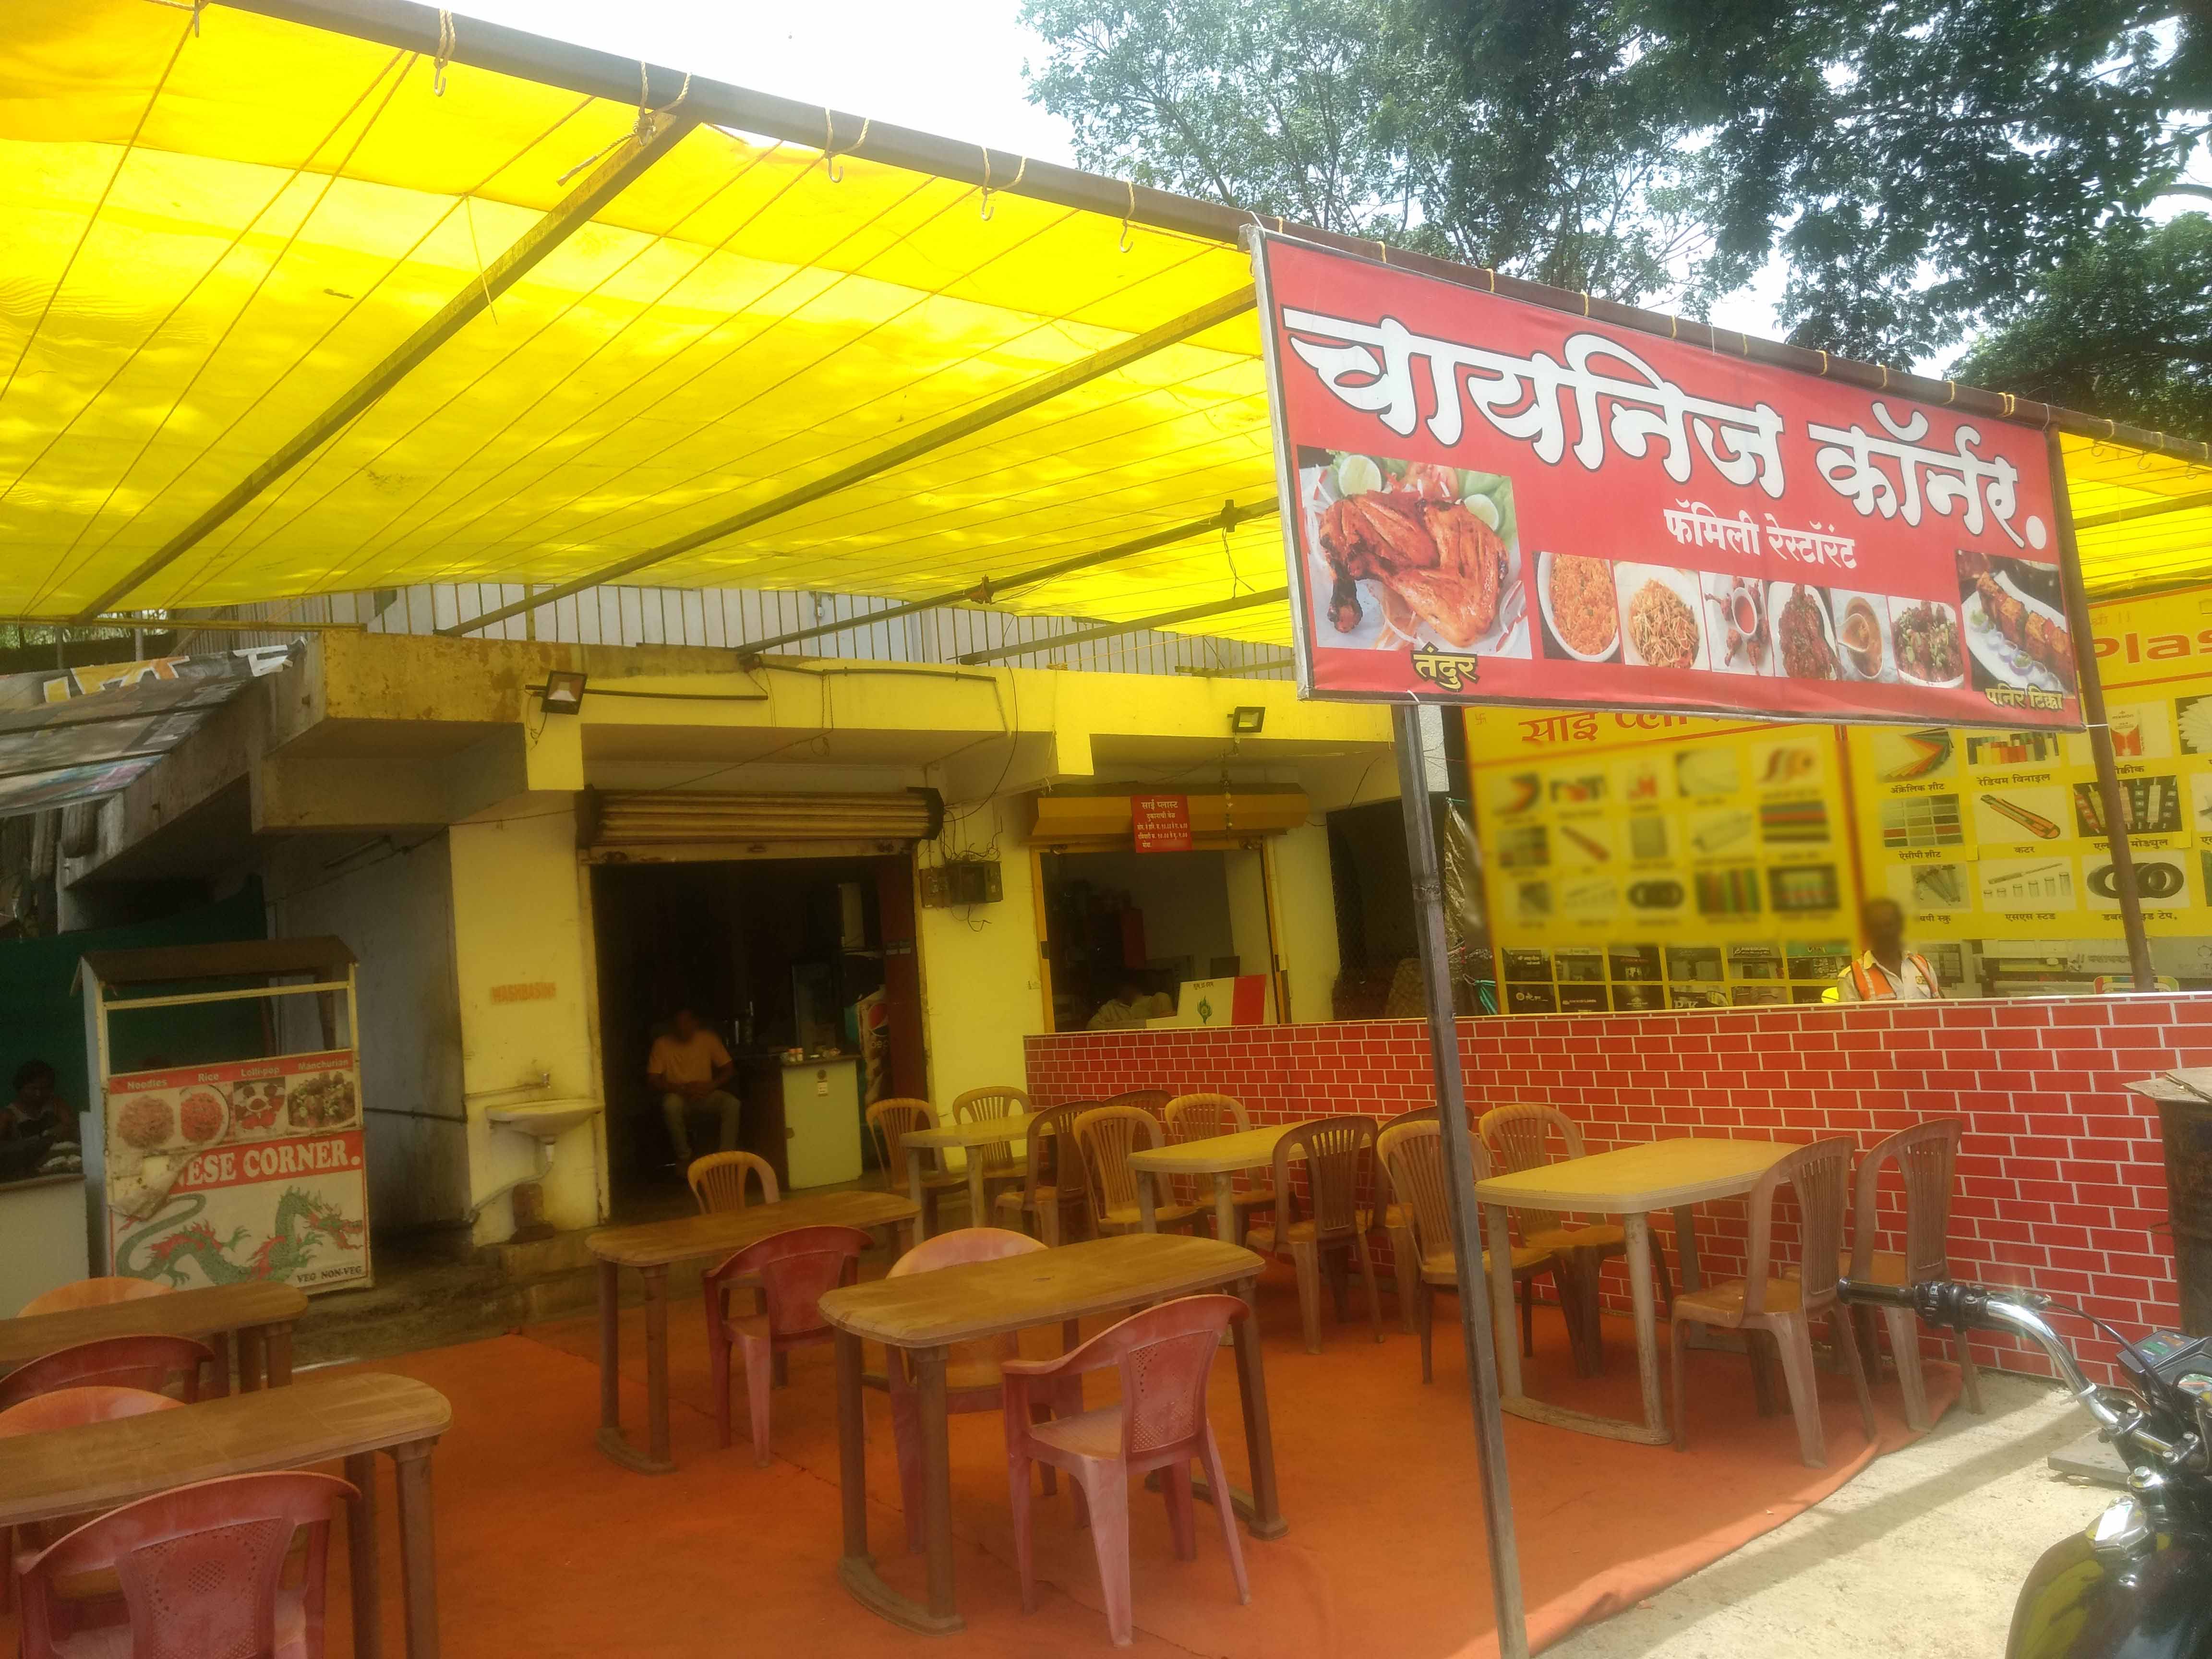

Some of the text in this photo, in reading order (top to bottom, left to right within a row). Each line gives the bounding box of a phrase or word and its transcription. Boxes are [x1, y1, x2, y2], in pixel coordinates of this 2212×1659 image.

[1281, 304, 1784, 499] चायनिज
[1663, 498, 1857, 569] फॅमिली रेस्टॉरंट
[2092, 629, 2212, 664] Pla
[1411, 642, 1479, 692] तंदुर
[1985, 682, 2026, 708] पनिर
[1928, 782, 1945, 791] शीट
[1976, 777, 2008, 786] रेडियम
[1141, 799, 1154, 810] साई
[1924, 850, 1941, 859] शीट
[2005, 913, 2033, 922] एसएस
[198, 1073, 219, 1082] Rice
[126, 1079, 168, 1090] Noodles
[297, 1273, 316, 1283] VEG
